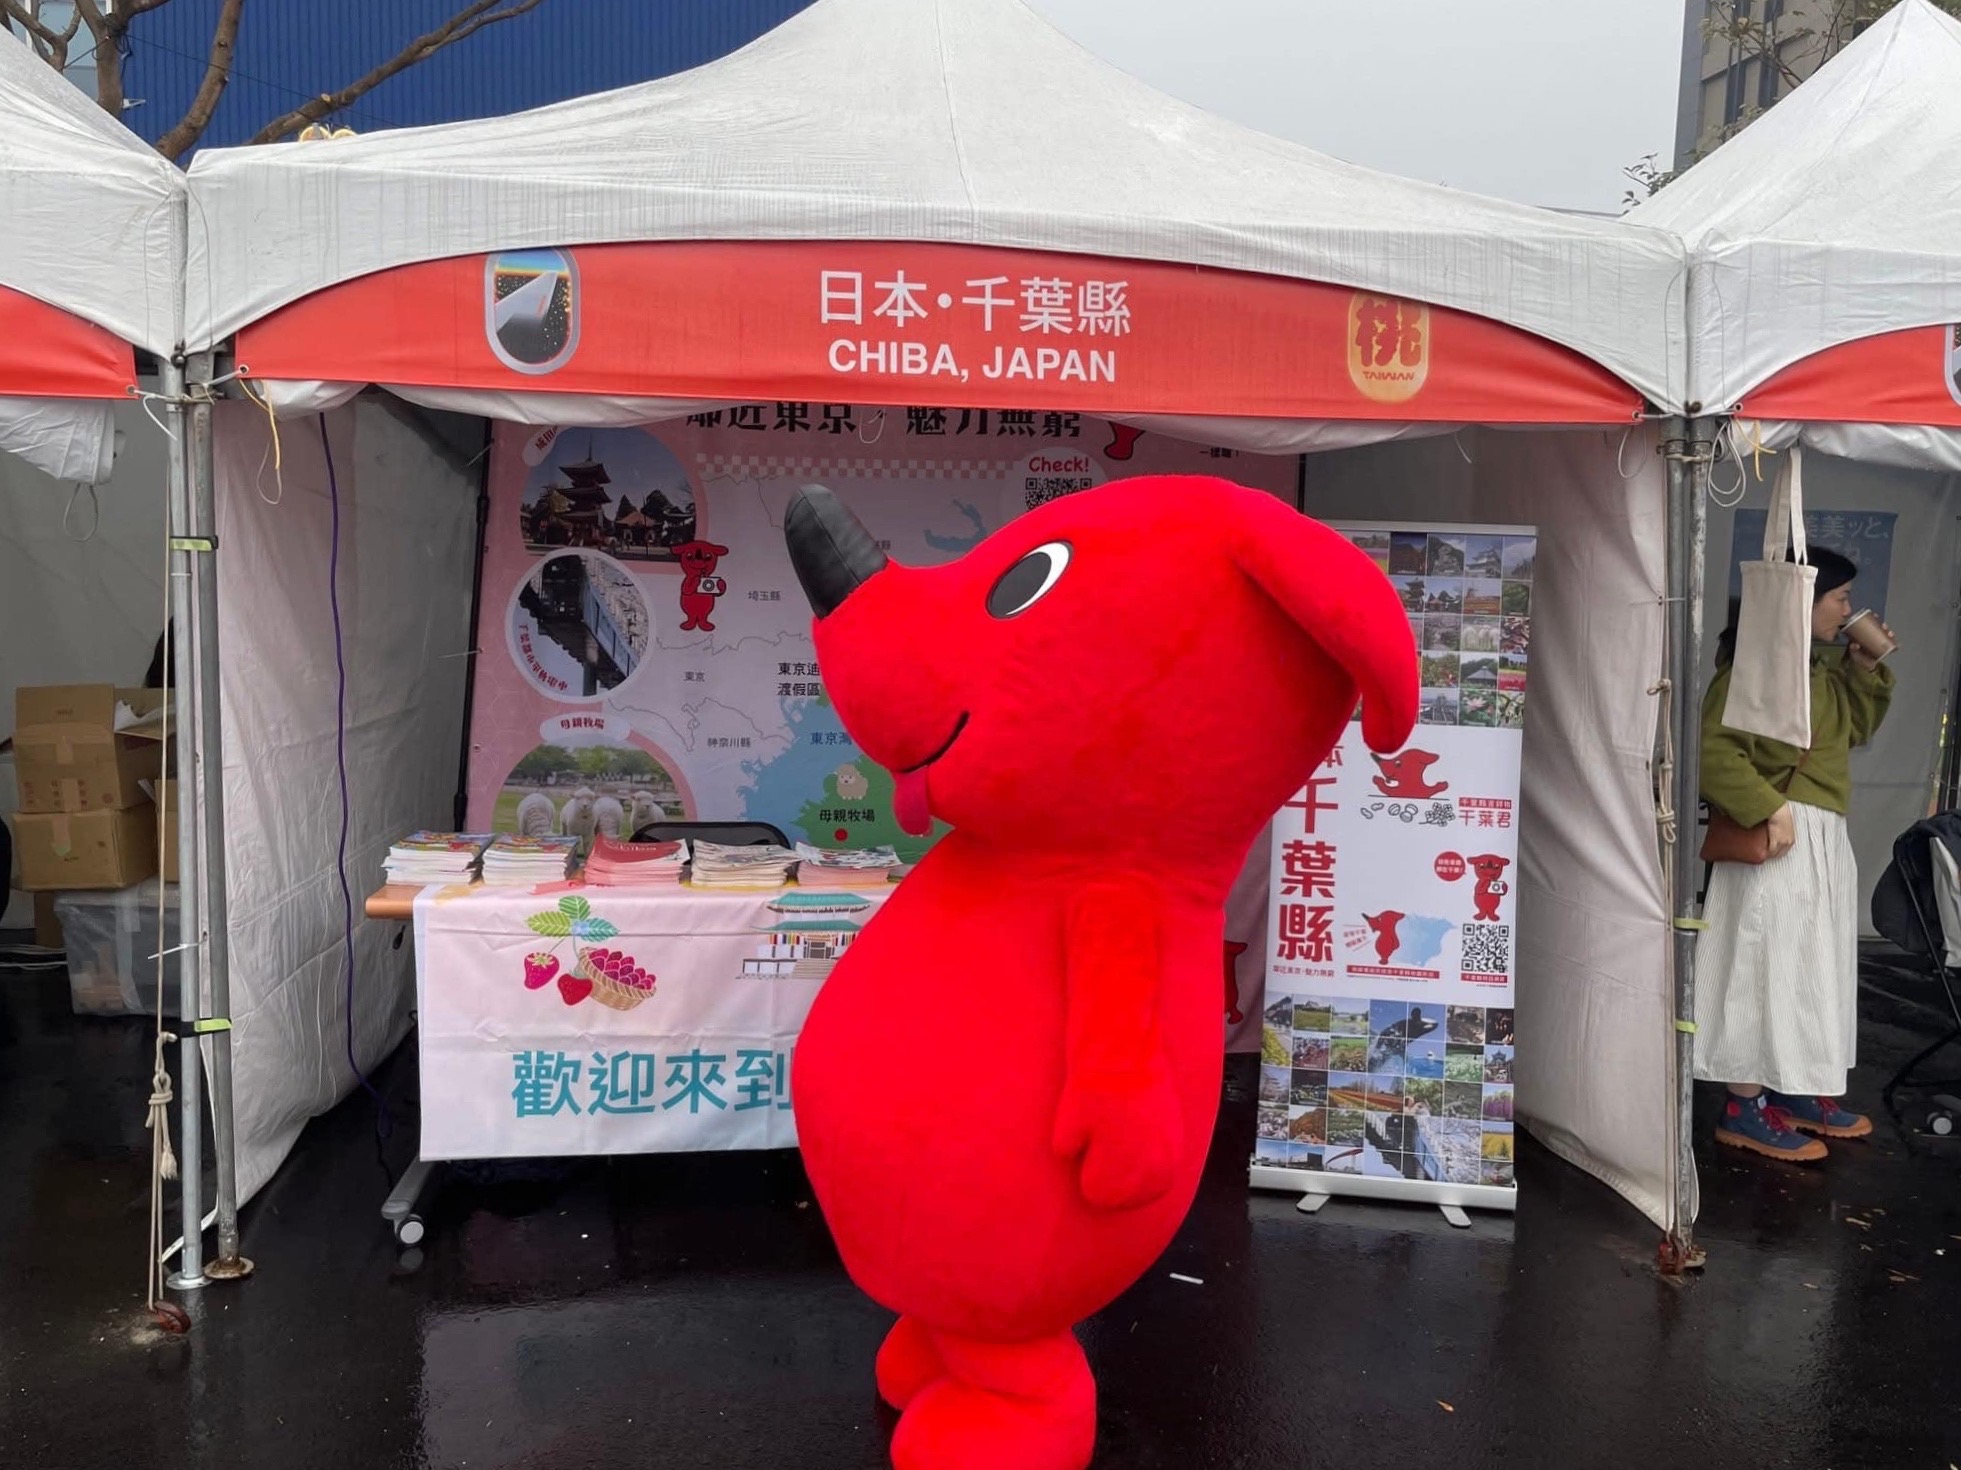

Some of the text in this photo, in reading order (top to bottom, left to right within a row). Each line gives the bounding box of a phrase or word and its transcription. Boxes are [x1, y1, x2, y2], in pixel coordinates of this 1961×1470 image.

[828, 339, 1116, 383] CHIBA, JAPAN
[1362, 371, 1416, 381] TAIWAN
[1029, 456, 1089, 472] Check!
[748, 590, 781, 601] 埼玉縣
[684, 671, 705, 682] 東京
[707, 737, 750, 749] 神奈川縣
[819, 809, 875, 823] 母親牧場
[1458, 809, 1511, 828] 千葉君
[512, 1049, 793, 1117] 歡迎來到
